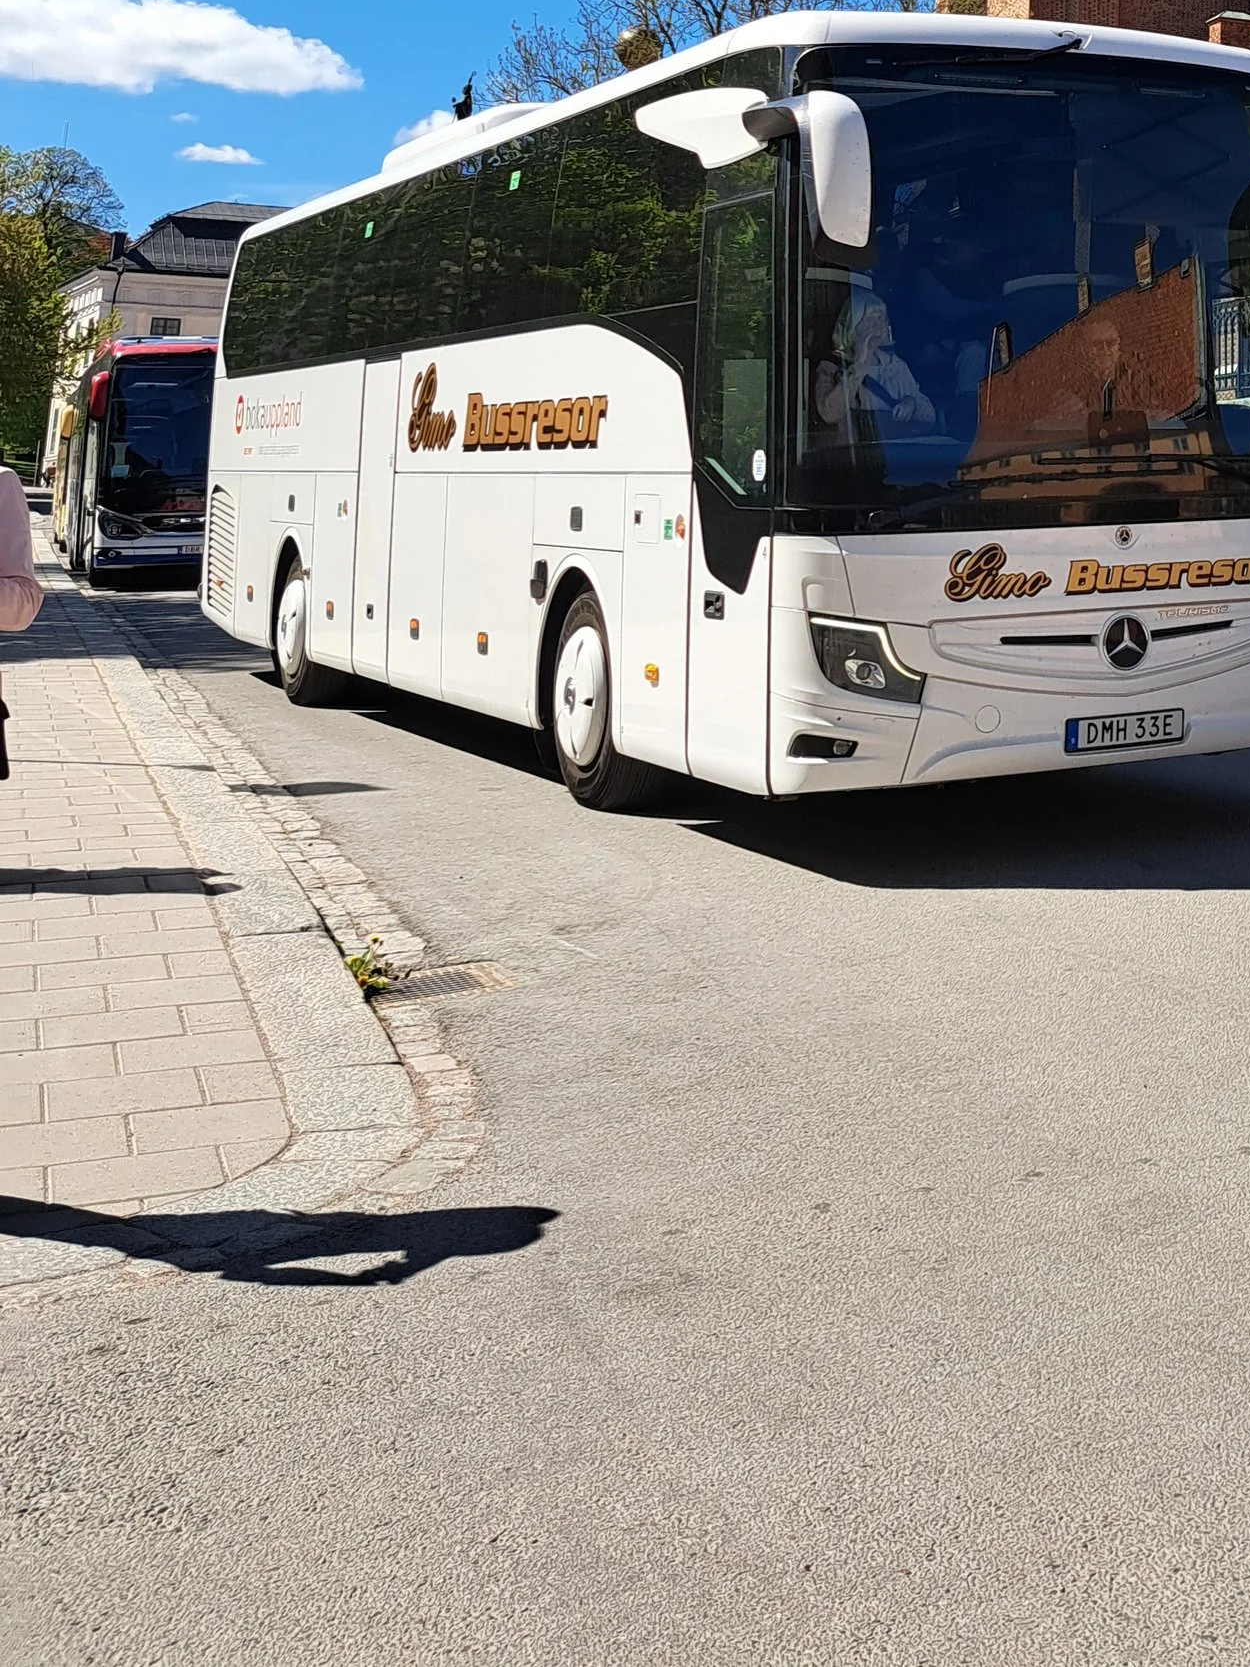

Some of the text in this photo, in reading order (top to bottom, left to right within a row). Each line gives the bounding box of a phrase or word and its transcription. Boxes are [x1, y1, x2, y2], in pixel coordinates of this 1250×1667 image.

[245, 391, 303, 438] bokauppland
[408, 362, 608, 453] Gimo Bussresor
[944, 542, 1052, 602] Gimo
[1157, 605, 1230, 618] TOURISMO
[1086, 714, 1173, 744] DMH 33E
